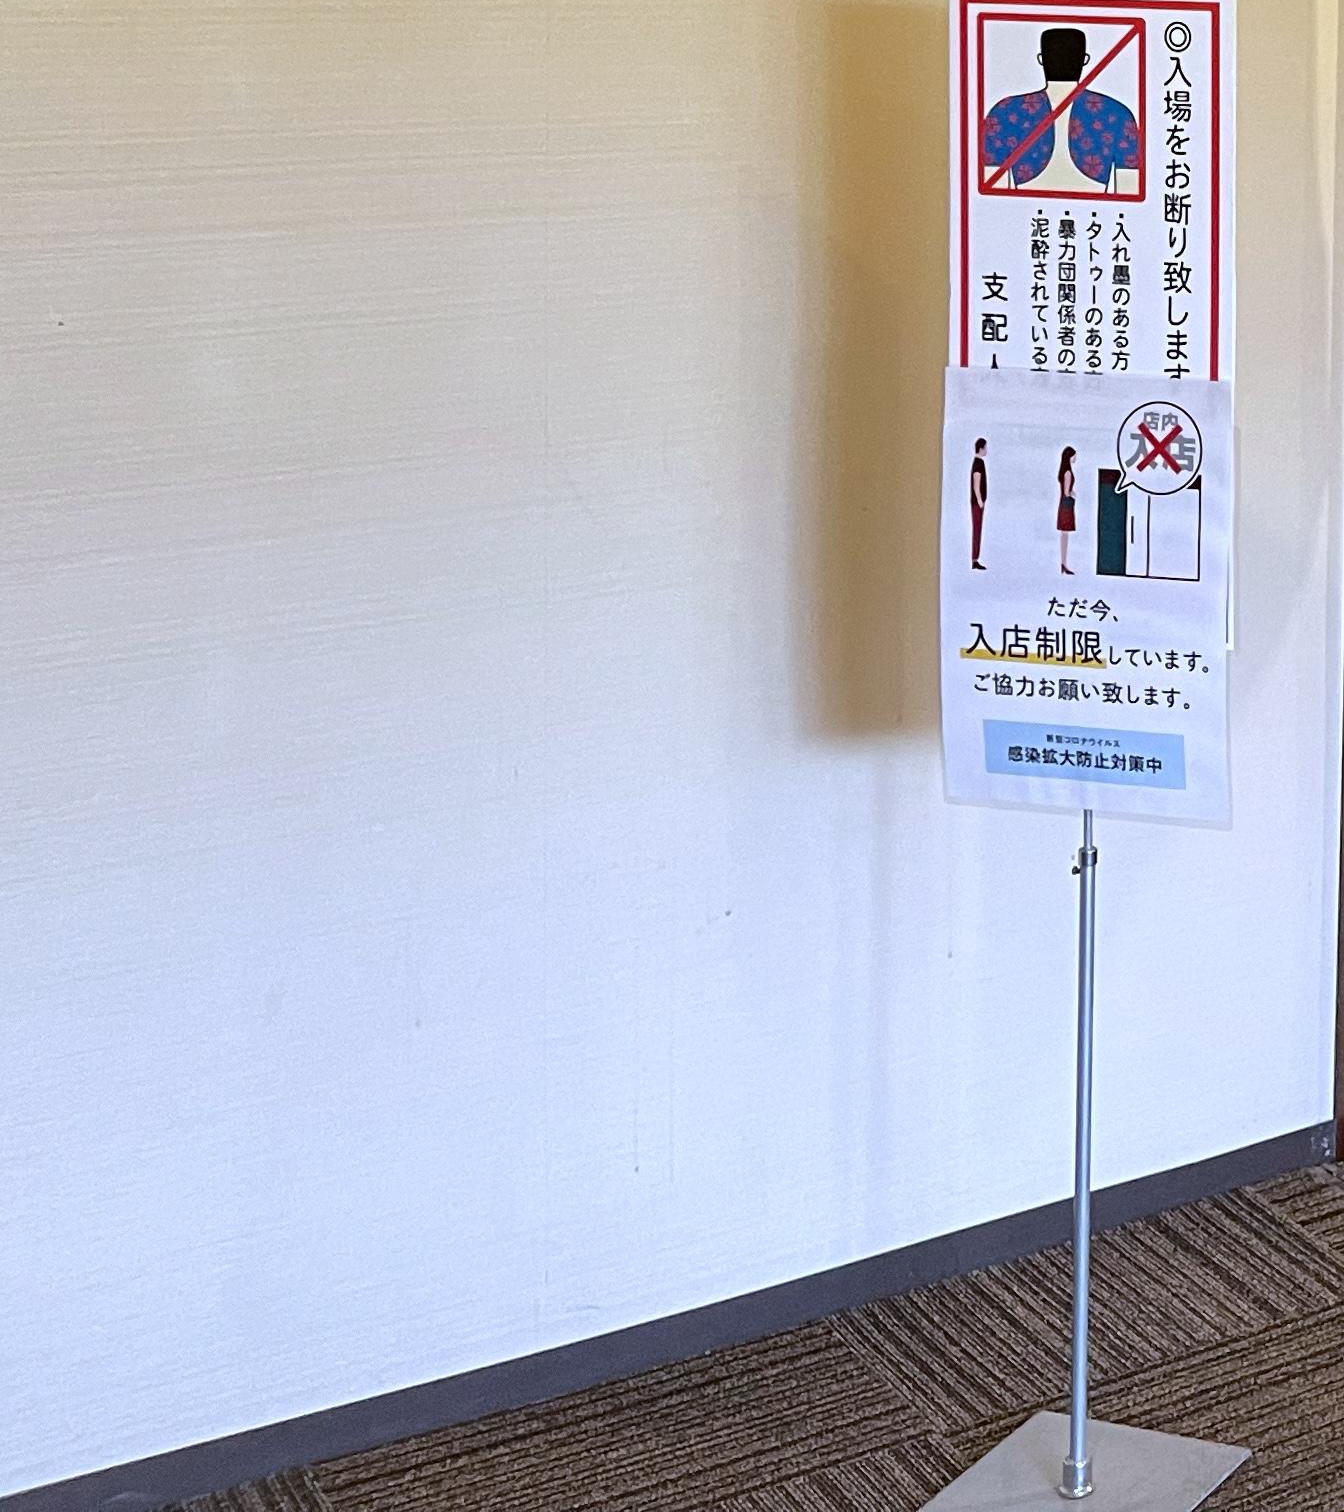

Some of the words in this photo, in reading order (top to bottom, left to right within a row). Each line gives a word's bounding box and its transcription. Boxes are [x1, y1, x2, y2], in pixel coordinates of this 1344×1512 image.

[1030, 209, 1049, 372] ・泥酔されている
[1056, 211, 1076, 374] ・暴力団関係者の
[1084, 212, 1103, 375] ・タトゥーのある
[1143, 412, 1178, 431] 店内
[1125, 433, 1196, 472] 入店
[1047, 597, 1119, 622] ただ今、
[966, 623, 1209, 673] 入店制限しています。
[974, 673, 1190, 710] ご協力お願い致します。
[1008, 745, 1162, 774] 感染拡大防止対策中
